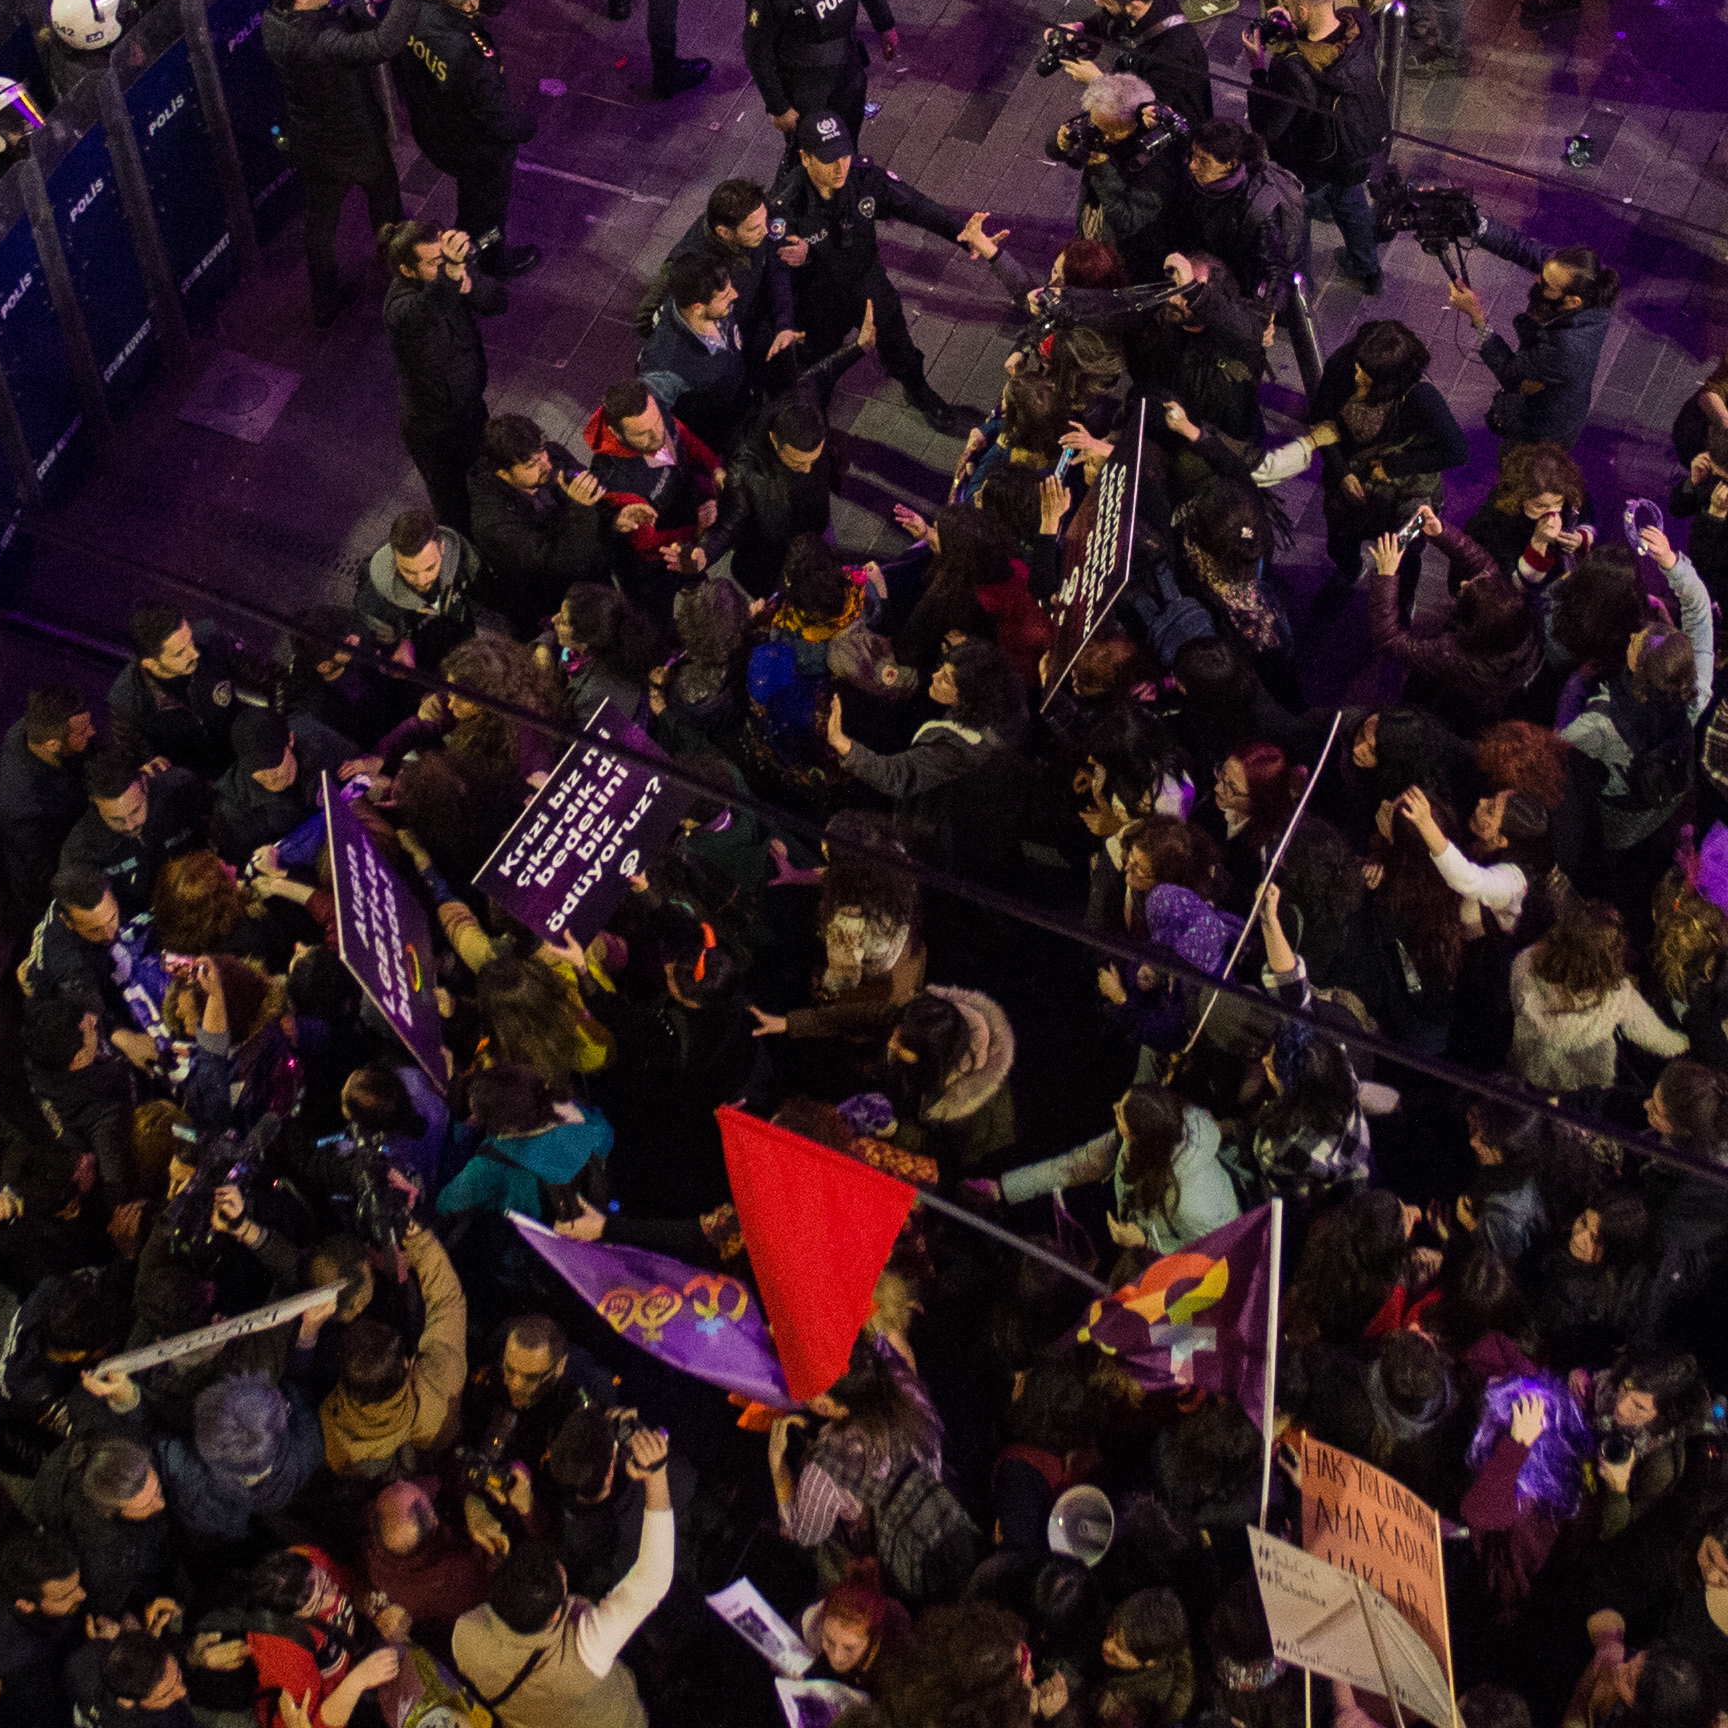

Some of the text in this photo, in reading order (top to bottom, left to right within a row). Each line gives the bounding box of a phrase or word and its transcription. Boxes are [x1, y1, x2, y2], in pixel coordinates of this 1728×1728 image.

[148, 93, 186, 137] POLİS
[69, 177, 105, 223] POLİS
[0, 271, 33, 320] POLİS
[498, 812, 550, 877] Krizi
[548, 769, 583, 810] biz
[516, 780, 598, 888] çıkardık
[534, 763, 630, 888] bedelini
[545, 776, 662, 933] ödüyoruz?
[576, 813, 616, 862] biz
[1303, 1442, 1347, 1489] HAK
[1314, 1496, 1370, 1545] AMA
[1375, 1512, 1433, 1580] KADIN
